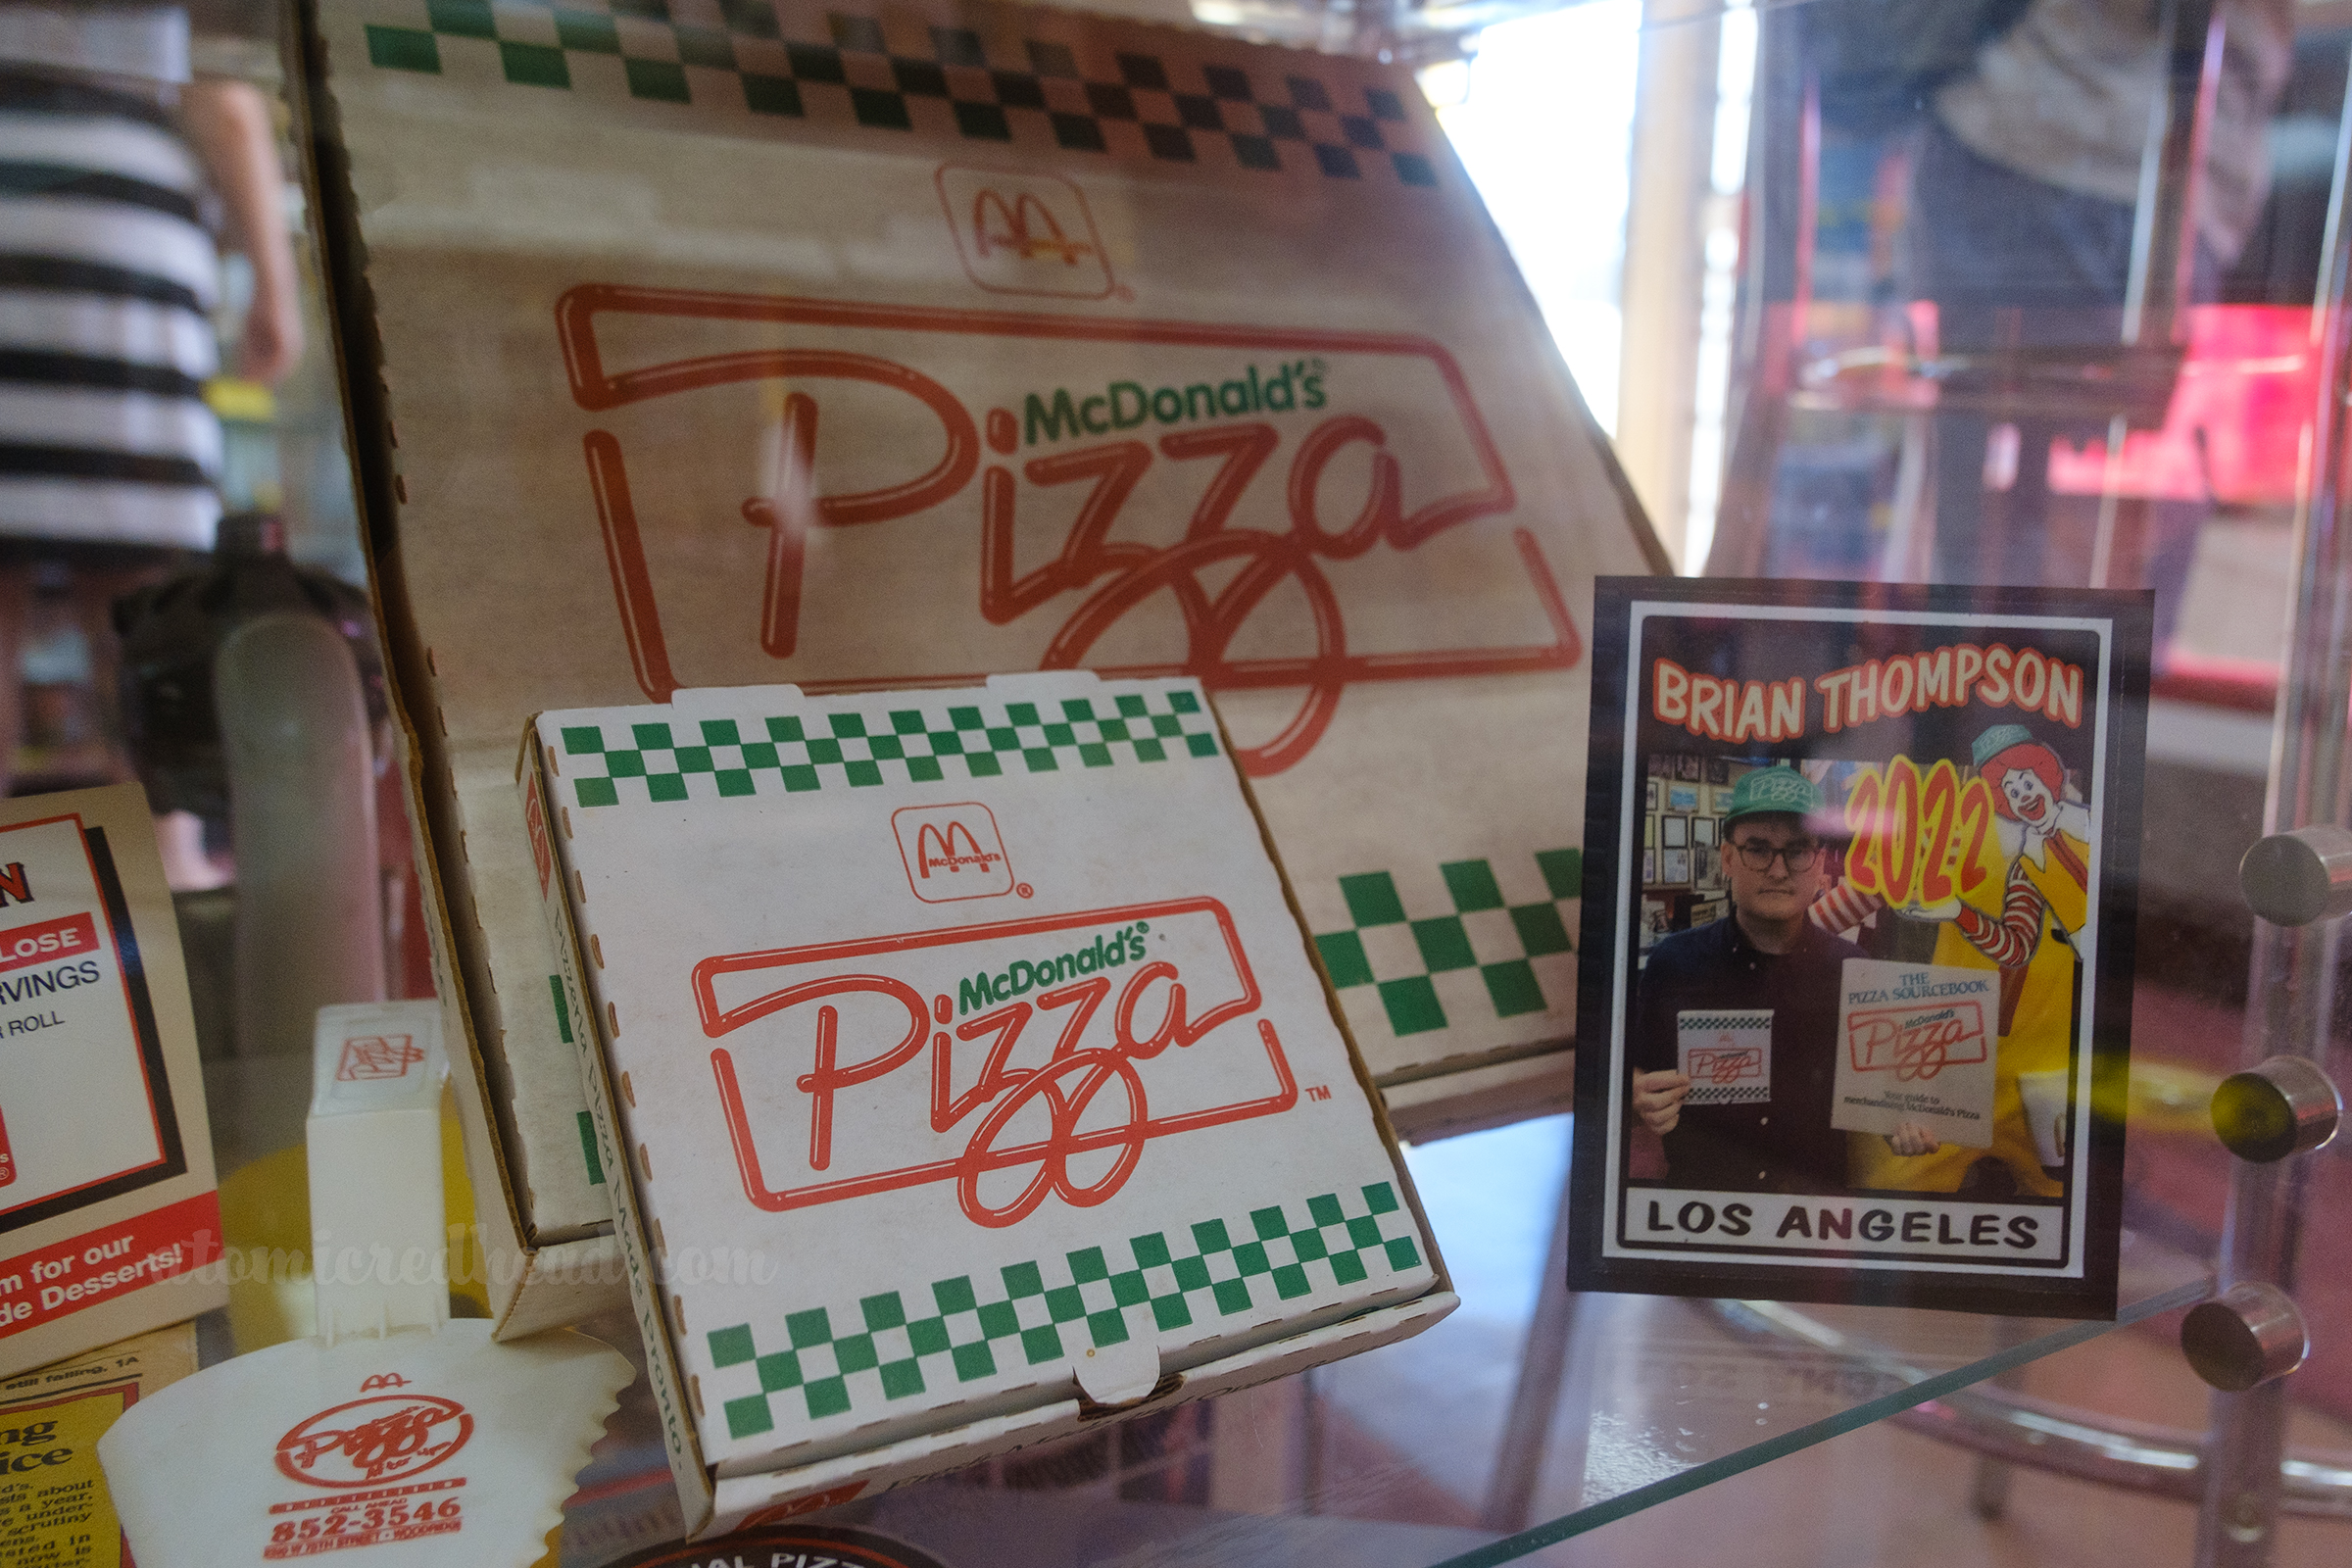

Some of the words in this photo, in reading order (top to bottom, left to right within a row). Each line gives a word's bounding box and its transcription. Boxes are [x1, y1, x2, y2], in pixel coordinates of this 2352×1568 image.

[1024, 360, 1327, 446] McDonald's
[598, 346, 1499, 777] Pizza
[1654, 658, 1805, 744] BRIAN
[1815, 644, 2082, 729] THOMPSON
[1844, 754, 1995, 908] 2022
[929, 853, 1002, 867] McDonald's
[959, 924, 1147, 1015] McDonald's
[1848, 990, 1889, 1004] PIZZA
[1892, 979, 1989, 1001] SOURCEBOOK
[1899, 972, 1930, 986] THE
[9, 1011, 66, 1037] ROLL
[1905, 1008, 1955, 1029] McDonald's
[1853, 1017, 1975, 1082] Pizza
[706, 960, 1259, 1231] Pizza
[613, 1178, 644, 1299] Made
[1647, 1200, 1753, 1236] LOS
[1776, 1206, 2038, 1250] ANGELES
[30, 1255, 75, 1284] for
[83, 1235, 134, 1264] our
[40, 1243, 182, 1310] Desserts!
[37, 1480, 95, 1498] about
[270, 1496, 462, 1544] 852-3546
